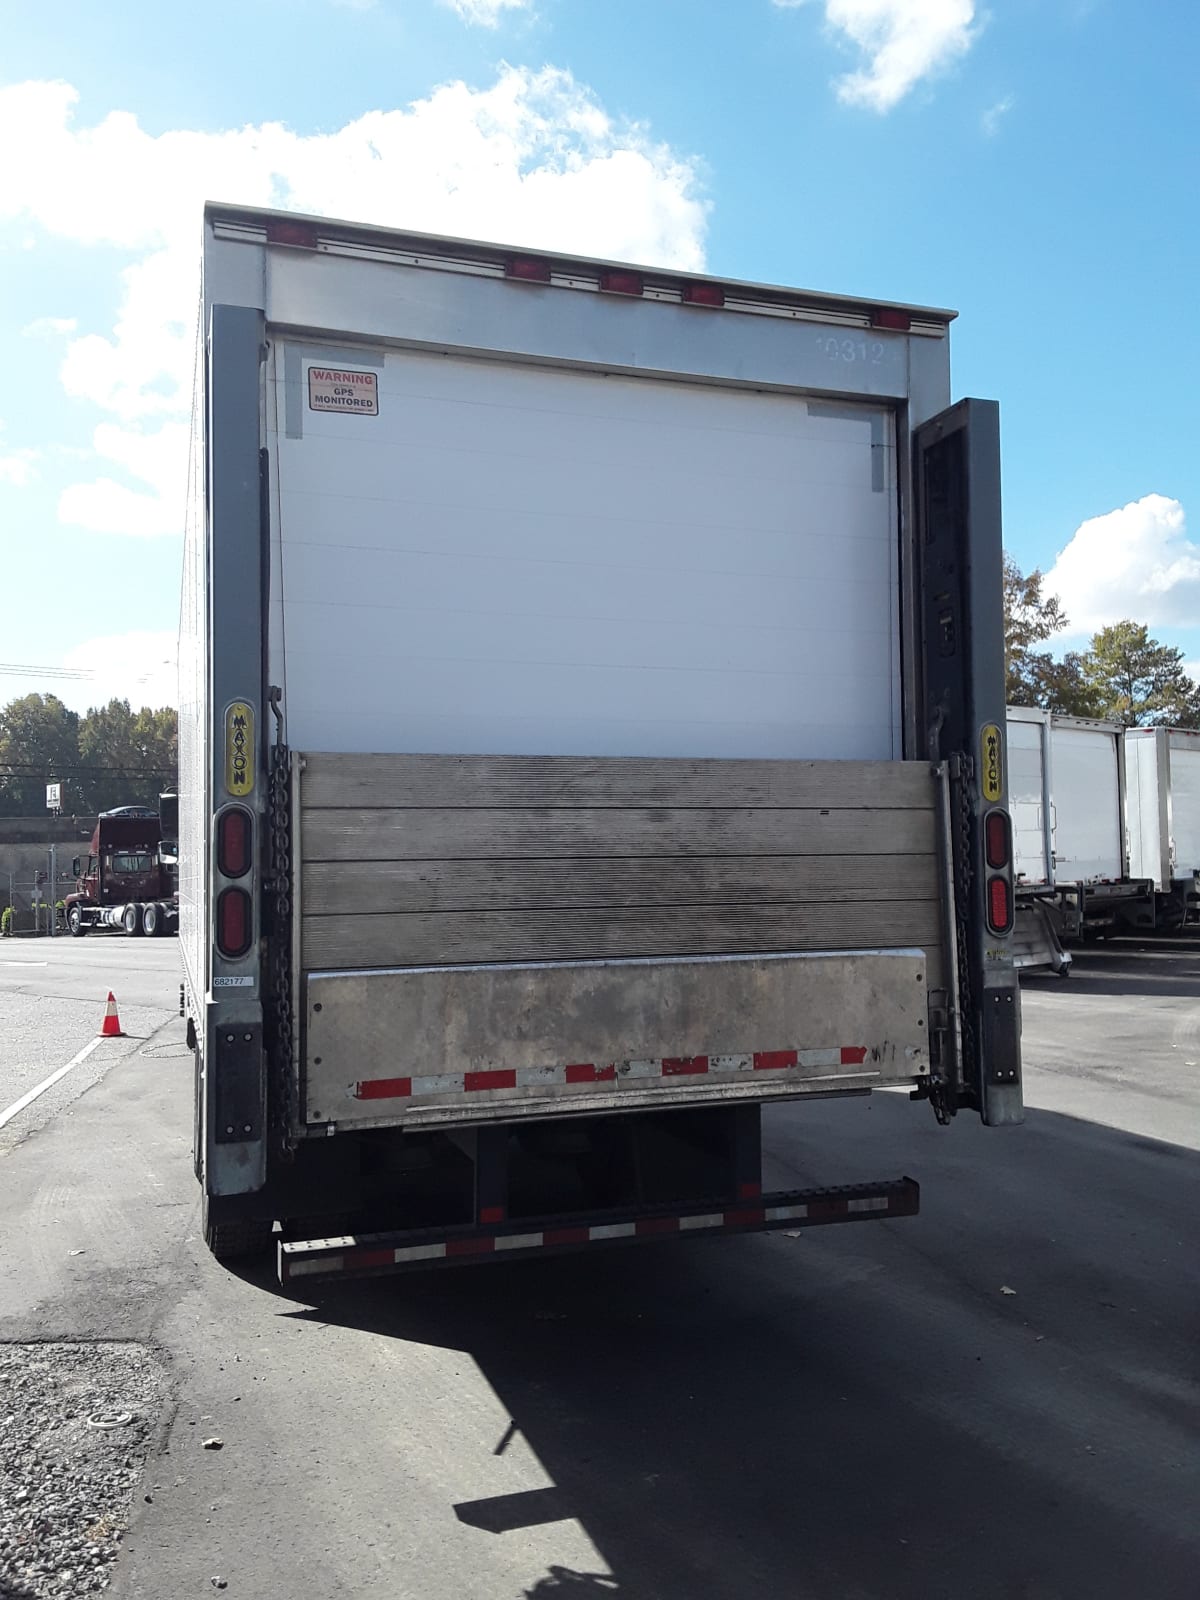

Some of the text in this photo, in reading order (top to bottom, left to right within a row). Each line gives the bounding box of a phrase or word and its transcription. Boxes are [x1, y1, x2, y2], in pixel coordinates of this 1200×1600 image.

[312, 370, 373, 384] WARNING
[334, 387, 354, 397] GPS
[314, 395, 373, 408] MONITORED
[231, 715, 247, 785] MAXON
[987, 735, 998, 792] MAXON
[214, 978, 244, 986] 682177
